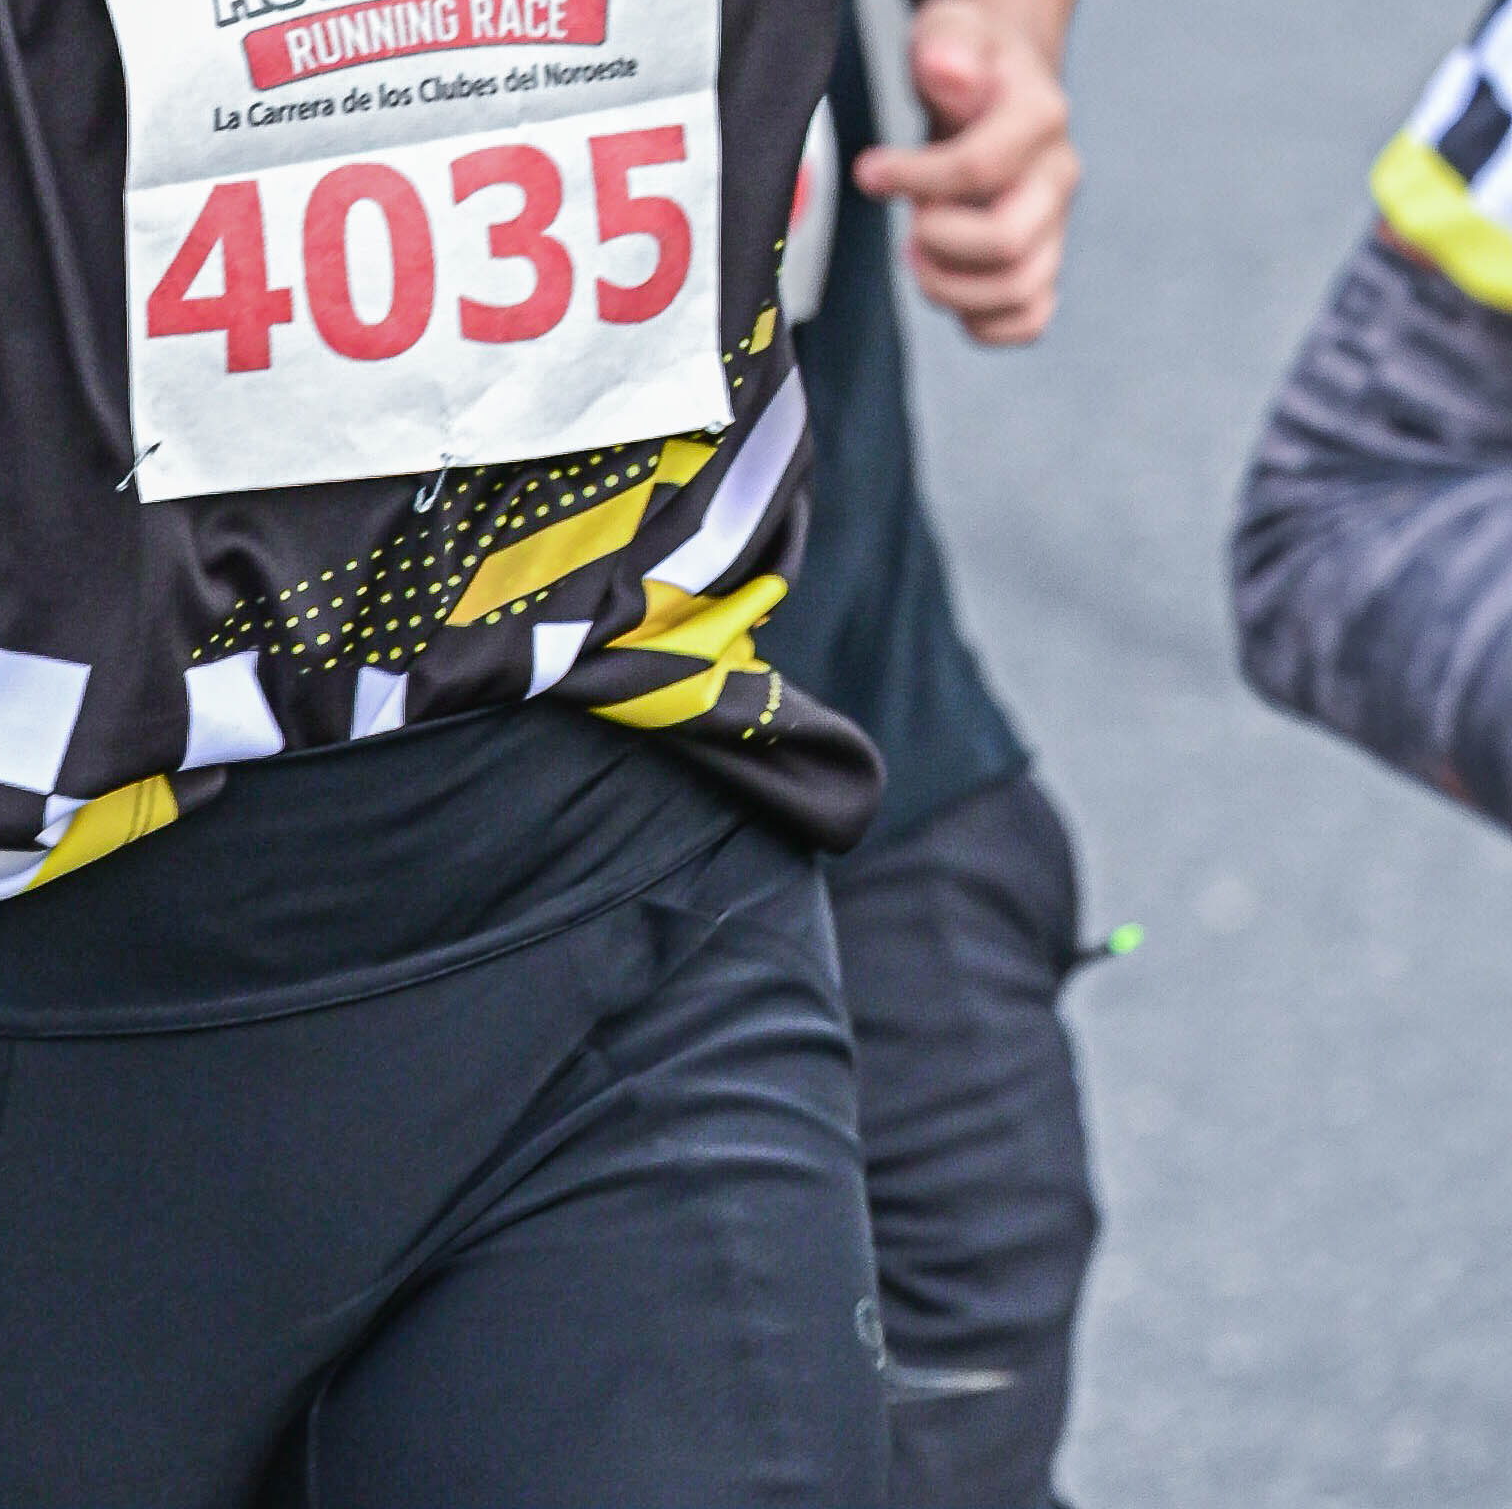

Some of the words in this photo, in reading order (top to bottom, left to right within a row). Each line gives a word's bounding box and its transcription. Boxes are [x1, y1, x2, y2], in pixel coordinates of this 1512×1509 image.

[213, 105, 241, 132] La
[247, 93, 335, 127] Carrera
[341, 85, 372, 114] de
[378, 82, 413, 109] los
[419, 71, 498, 103] Clubes
[504, 63, 539, 92] del
[543, 56, 638, 88] Noroeste
[146, 123, 691, 374] 4035
